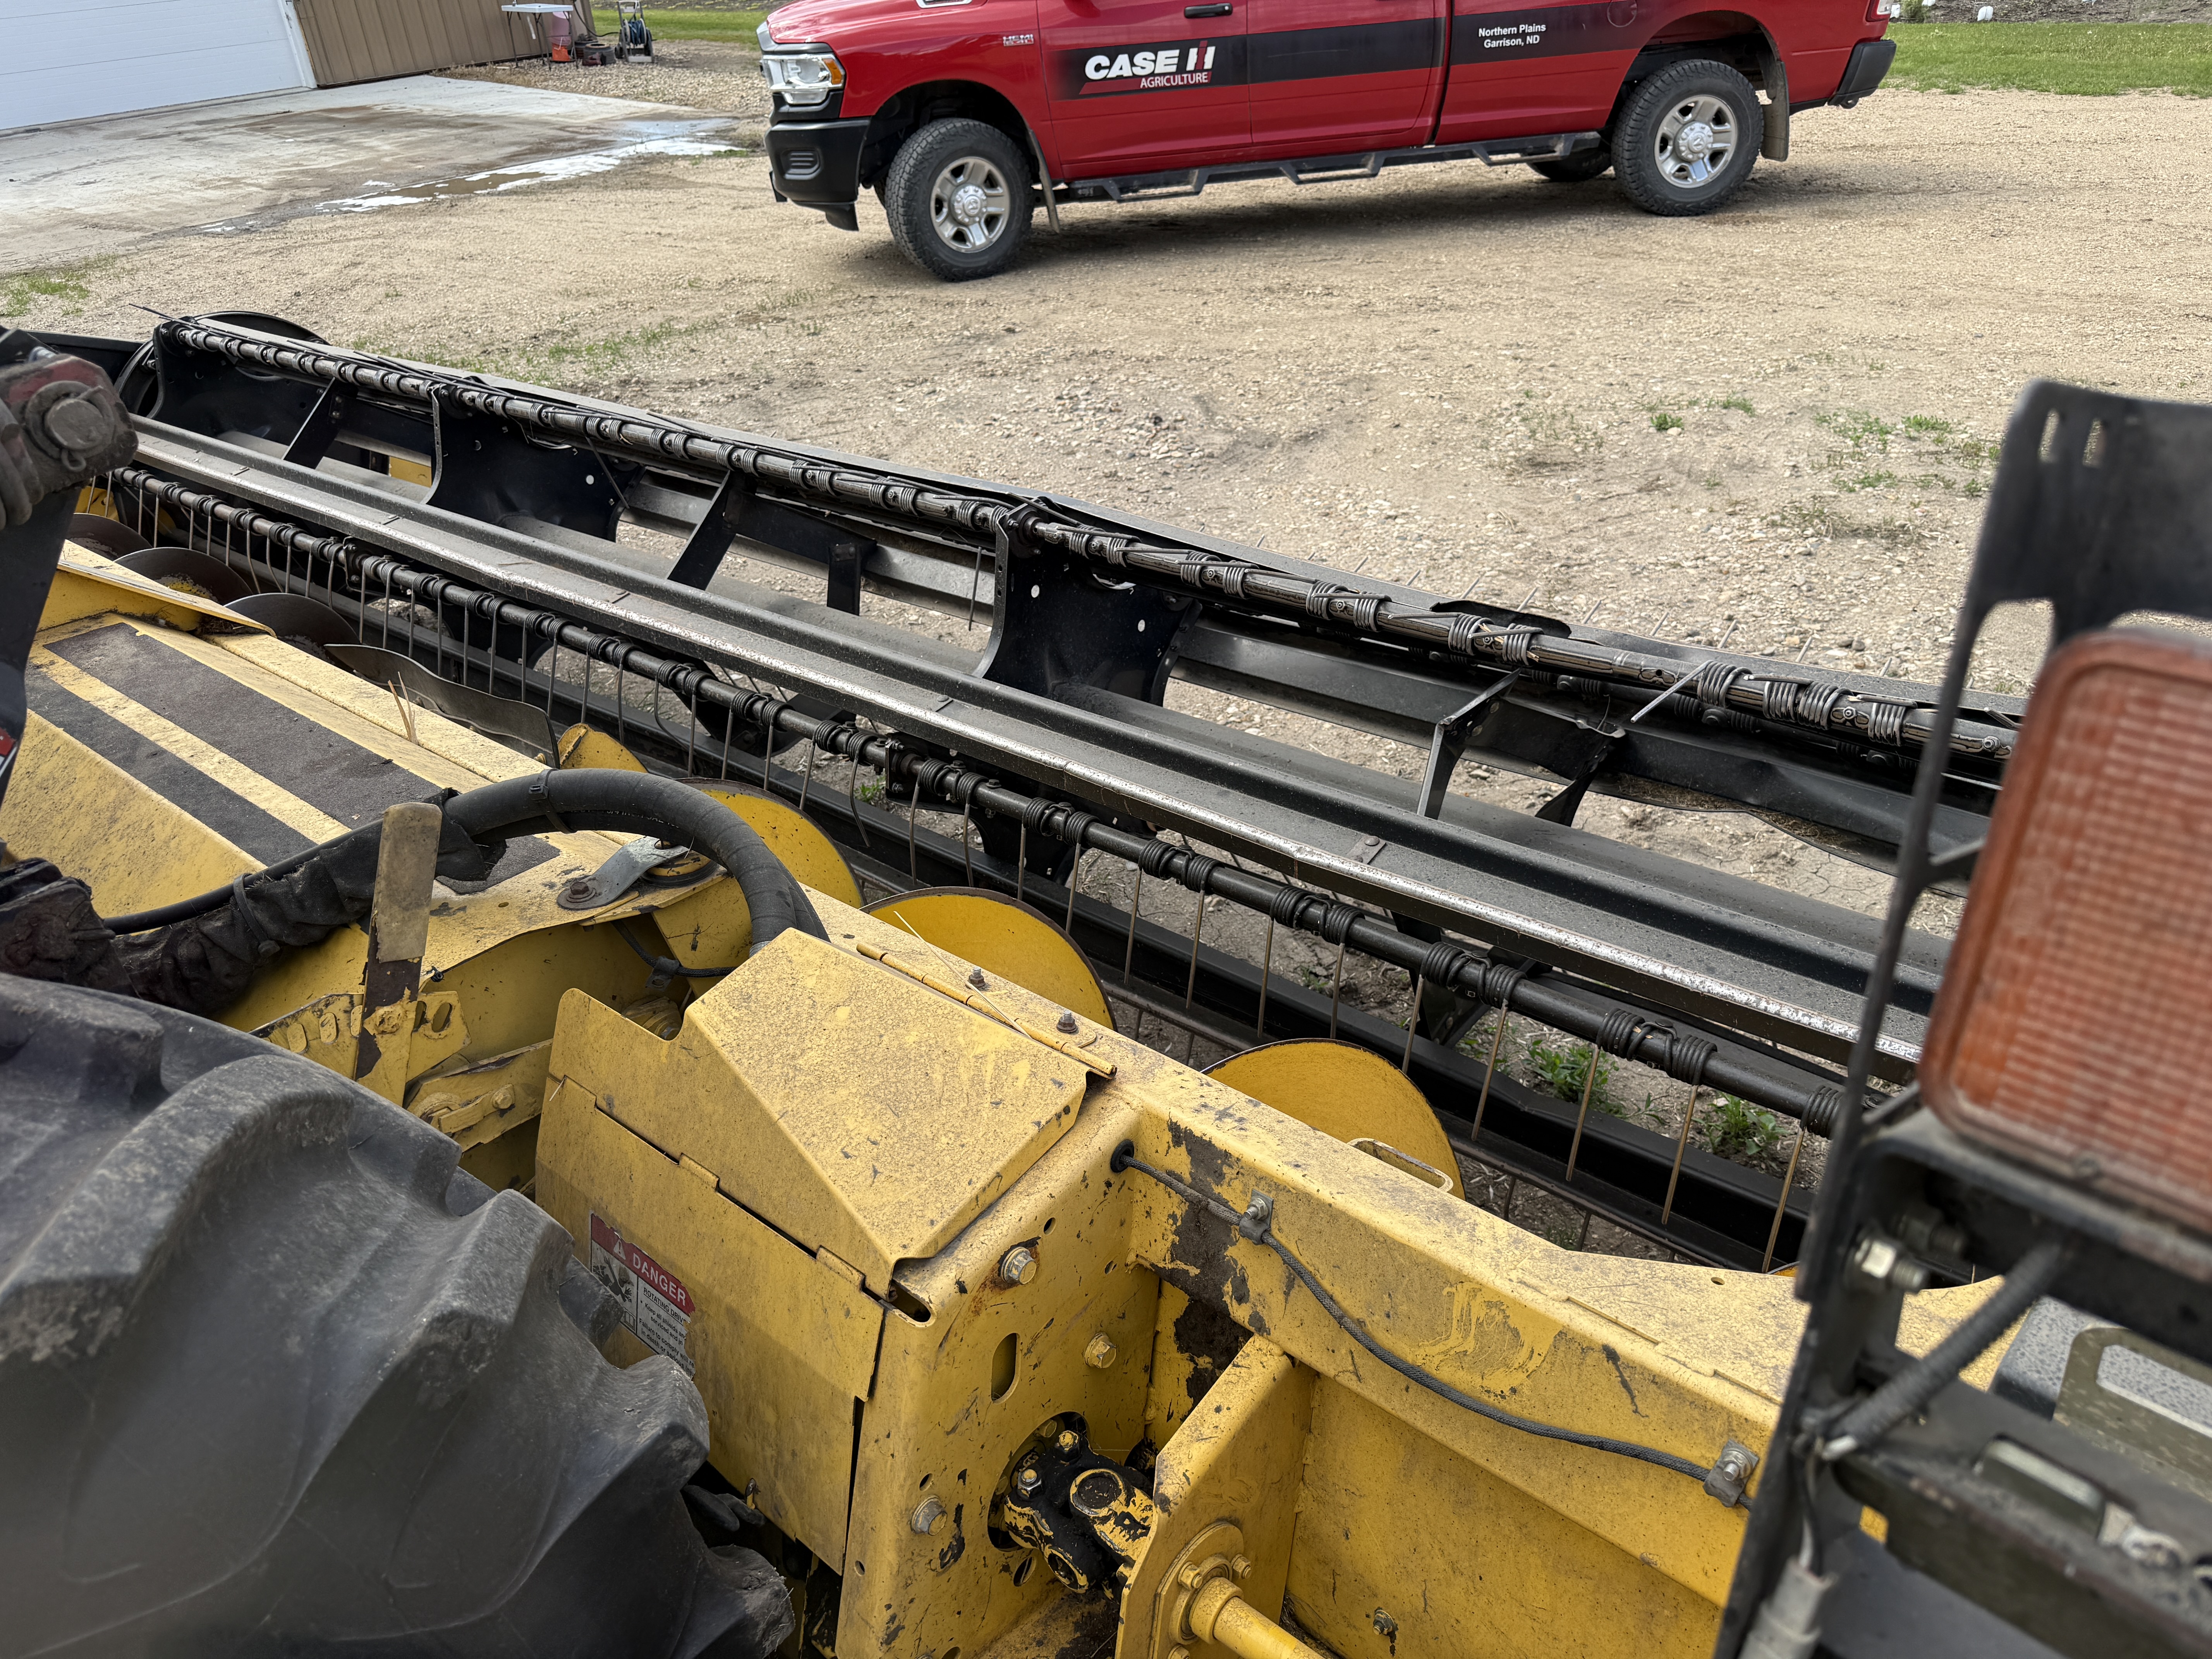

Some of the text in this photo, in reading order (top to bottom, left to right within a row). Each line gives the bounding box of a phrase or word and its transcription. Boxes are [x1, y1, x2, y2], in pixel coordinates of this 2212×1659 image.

[1478, 24, 1546, 37] Northern Plains
[1484, 35, 1540, 48] Garrison, ND
[1085, 49, 1180, 80] CASE
[1140, 72, 1209, 89] AGRICULTURE
[633, 1252, 686, 1307] DANGER
[643, 1287, 670, 1312] ROTATING
[645, 1303, 656, 1316] Keep
[663, 1317, 678, 1333] shields
[651, 1316, 669, 1334] serviced
[670, 1332, 678, 1341] and
[639, 1318, 655, 1335] Failure
[661, 1338, 679, 1356] comply
[680, 1353, 689, 1363] will
[641, 1328, 646, 1336] in
[646, 1334, 659, 1348] death
[667, 1351, 685, 1369] serious
